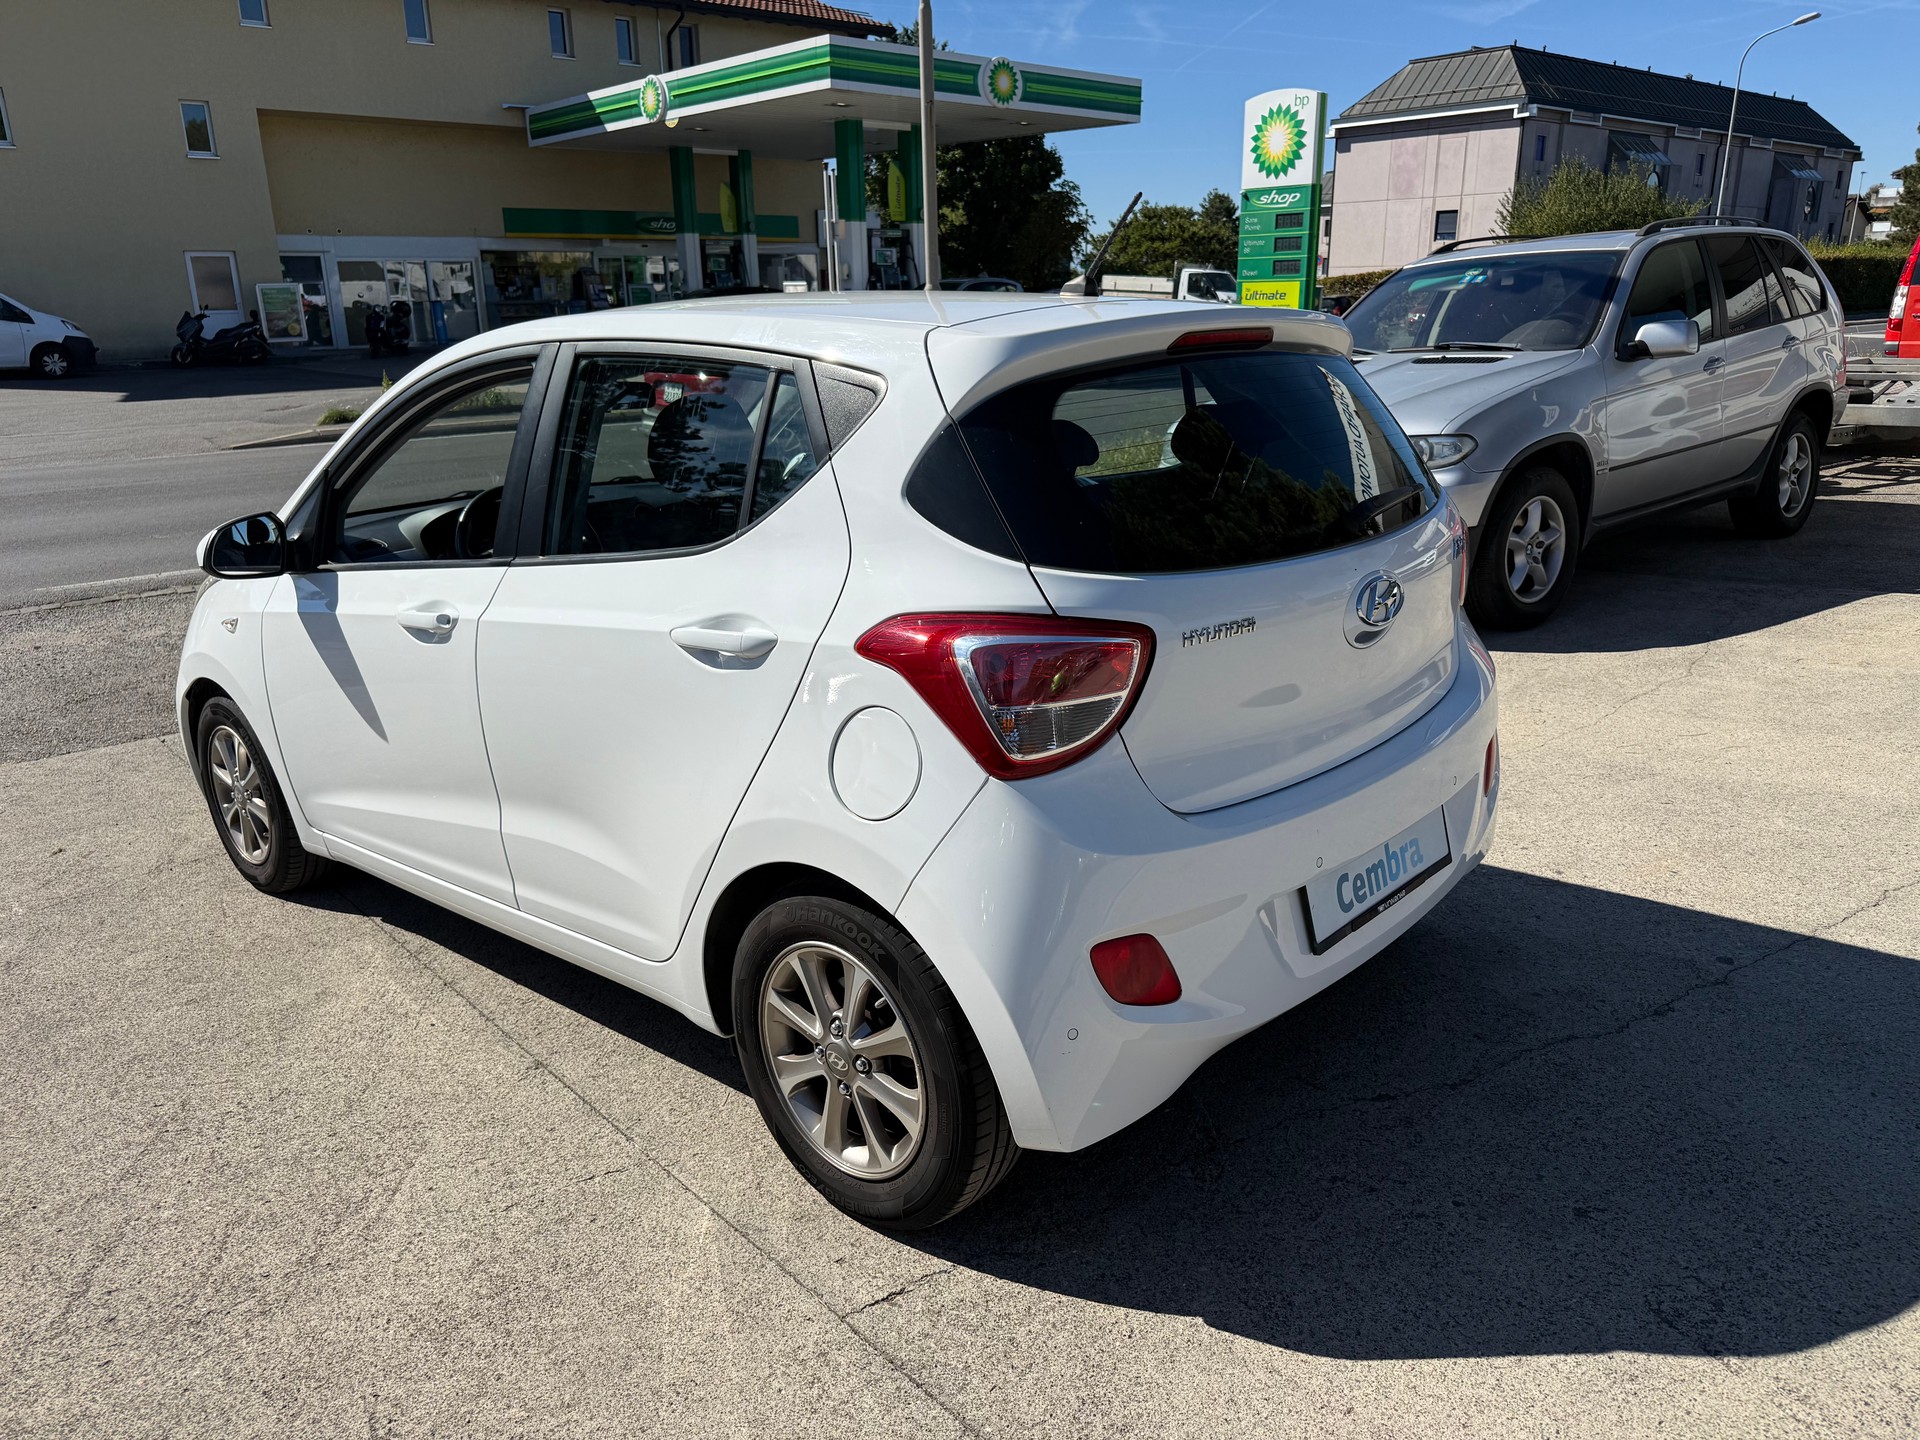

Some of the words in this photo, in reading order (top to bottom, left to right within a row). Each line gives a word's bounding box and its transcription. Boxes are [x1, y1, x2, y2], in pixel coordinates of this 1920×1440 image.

[1294, 93, 1310, 110] bp
[1260, 190, 1301, 207] shop
[650, 218, 677, 231] sho
[1245, 290, 1287, 301] ultimate
[1182, 616, 1257, 648] HYUNDAI
[1336, 837, 1424, 914] Cembra
